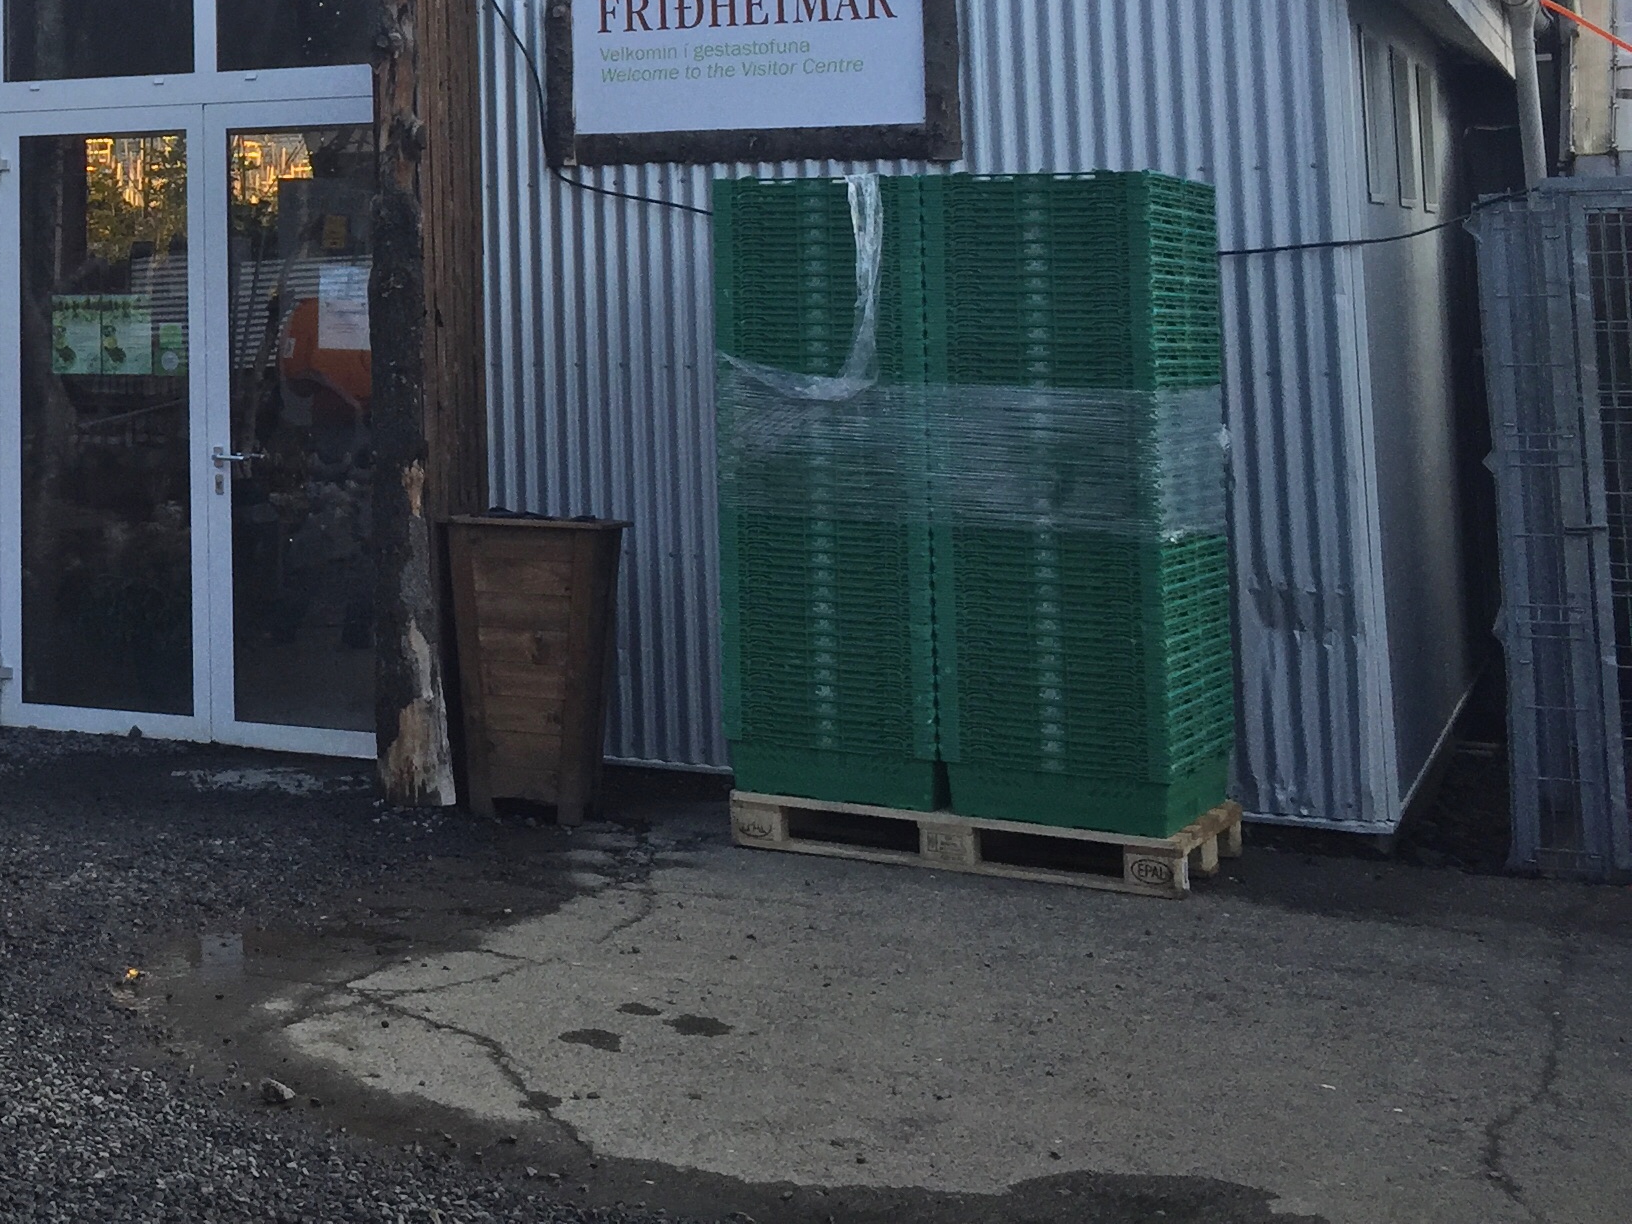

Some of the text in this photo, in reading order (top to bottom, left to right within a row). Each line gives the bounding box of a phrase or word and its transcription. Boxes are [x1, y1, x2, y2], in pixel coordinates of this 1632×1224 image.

[599, 44, 678, 63] Velkomin
[693, 39, 811, 61] gestastofuna
[601, 57, 865, 83] Welcome to the Visitor Centre
[1137, 863, 1167, 881] EPAL
